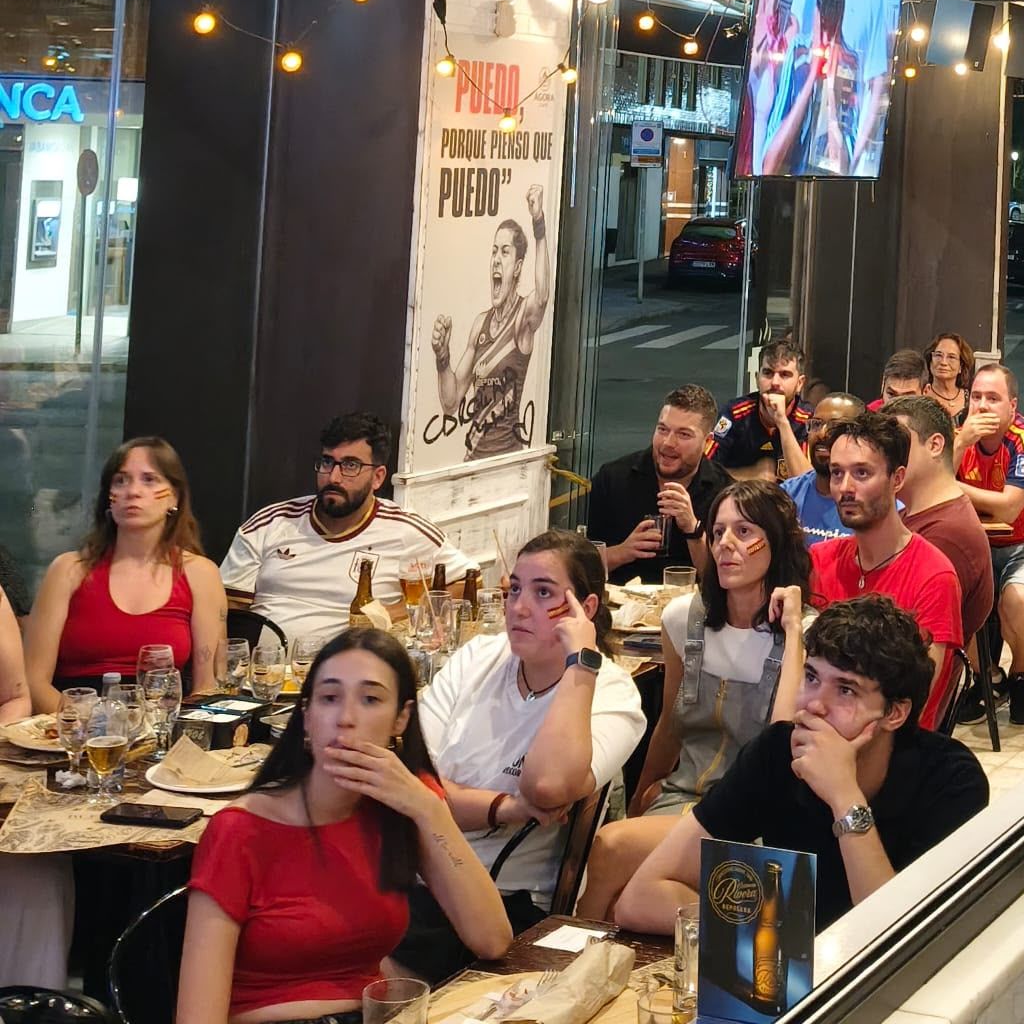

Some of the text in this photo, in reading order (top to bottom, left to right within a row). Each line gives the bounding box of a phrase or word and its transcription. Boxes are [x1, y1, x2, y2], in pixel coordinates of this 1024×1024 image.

[441, 128, 553, 163] PORQUE PIENSO QUE
[438, 167, 512, 218] PUEDO”
